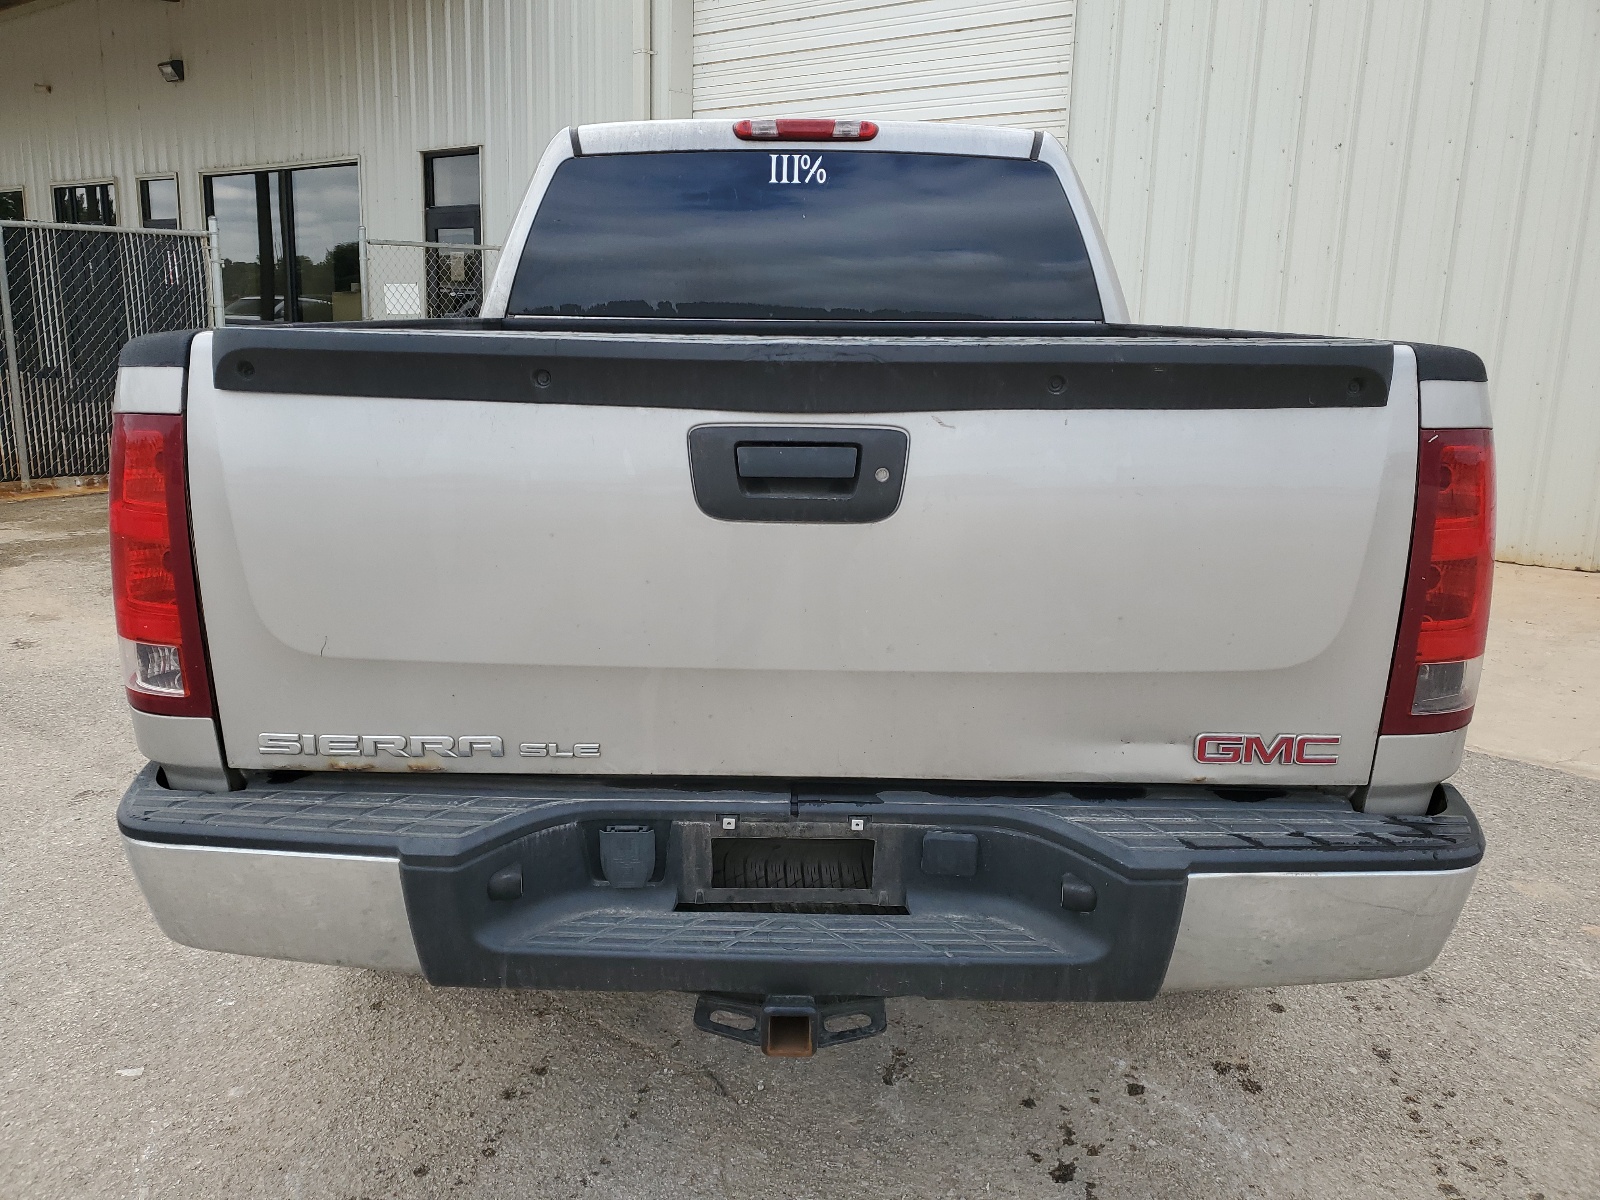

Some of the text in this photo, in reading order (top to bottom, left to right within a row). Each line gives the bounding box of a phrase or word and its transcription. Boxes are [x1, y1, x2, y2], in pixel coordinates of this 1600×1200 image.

[769, 154, 827, 184] III%
[258, 732, 601, 758] SIERRA SLE
[1194, 732, 1341, 765] GMC
